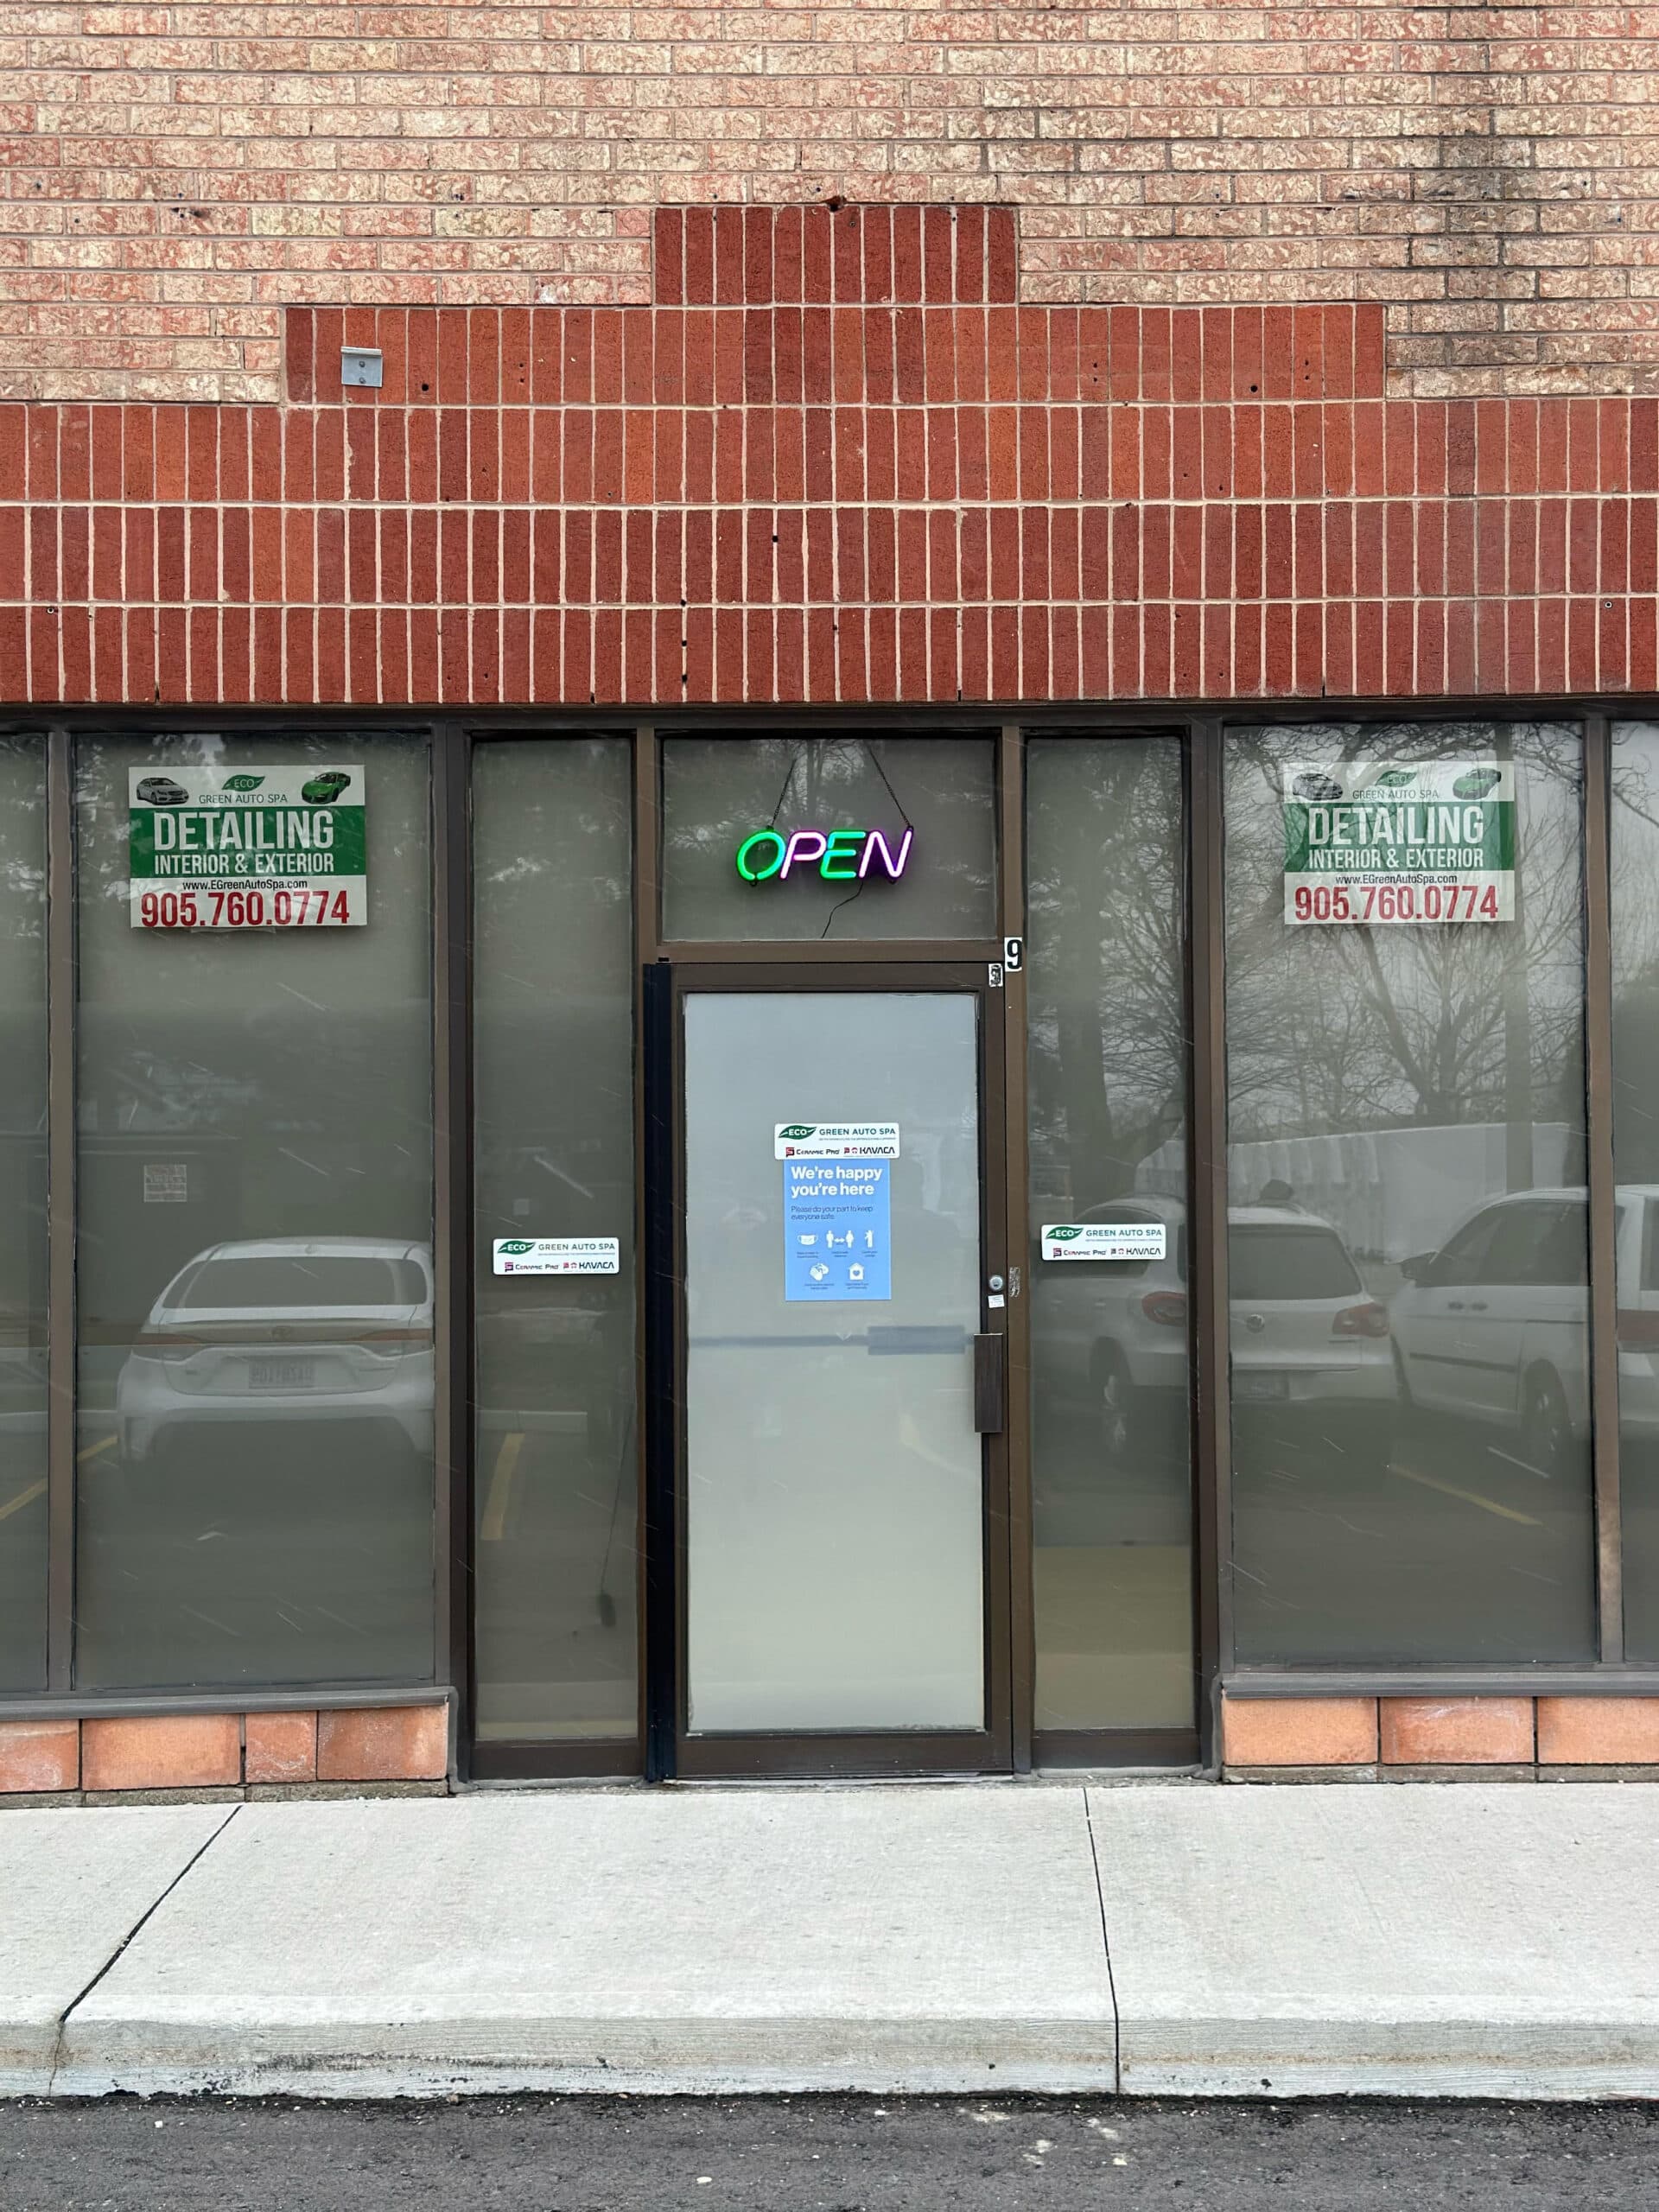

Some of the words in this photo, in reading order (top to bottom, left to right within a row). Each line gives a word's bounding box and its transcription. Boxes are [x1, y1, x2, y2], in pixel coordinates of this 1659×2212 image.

[199, 794, 232, 804] GREEN
[236, 794, 264, 804] AUTO
[268, 793, 287, 803] SPA
[1352, 790, 1383, 799] GREEN
[1388, 790, 1416, 799] AUTO
[1420, 790, 1439, 798] SPA
[154, 810, 334, 850] DETAILING
[1308, 806, 1484, 845] DETAILING
[155, 855, 230, 874] INTERIOR
[235, 854, 248, 873] &
[255, 853, 334, 873] EXTERIOR
[737, 830, 913, 880] OPEN
[1309, 849, 1381, 869] INTERIOR
[1387, 849, 1399, 868] &
[1406, 848, 1484, 868] EXTERIOR
[182, 880, 308, 891] www.EGreenAutoSpa.com
[1336, 874, 1457, 886] www.EGreenAutoSpa.com
[141, 890, 349, 927] 905.760.0774
[1295, 885, 1498, 920] 905.760.0774
[1007, 939, 1022, 969] 9
[791, 1166, 834, 1179] We're
[836, 1166, 882, 1181] happy
[791, 1183, 837, 1198] you're
[840, 1183, 874, 1195] here
